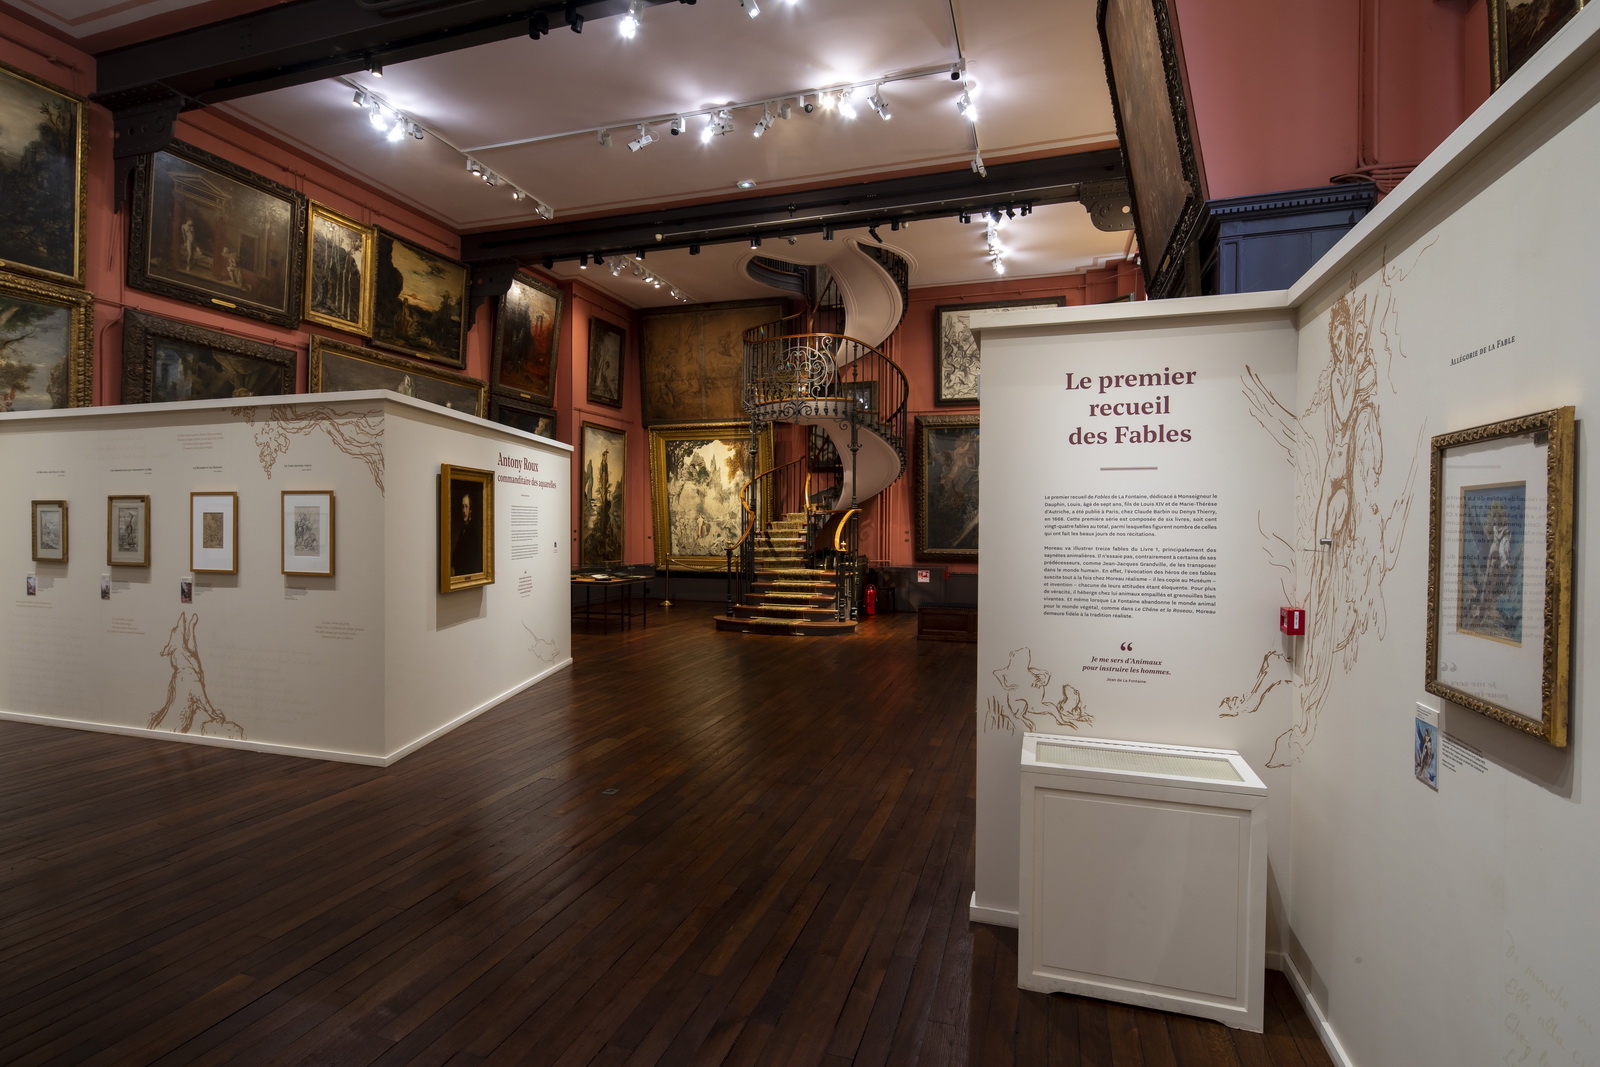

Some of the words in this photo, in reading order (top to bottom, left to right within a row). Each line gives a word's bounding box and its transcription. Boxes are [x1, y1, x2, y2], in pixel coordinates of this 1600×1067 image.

[1450, 350, 1478, 366] ALLÉGORIE
[1497, 336, 1515, 348] FABLE
[1065, 372, 1092, 390] Le
[1099, 367, 1197, 394] premier
[1089, 395, 1170, 417] recueil
[1069, 427, 1107, 445] des
[1114, 424, 1192, 444] Fables
[497, 452, 522, 473] Antony
[524, 457, 538, 472] Roux
[497, 474, 530, 486] commanditaire
[538, 478, 556, 490] aquarelles
[1124, 658, 1162, 666] d'Animaux
